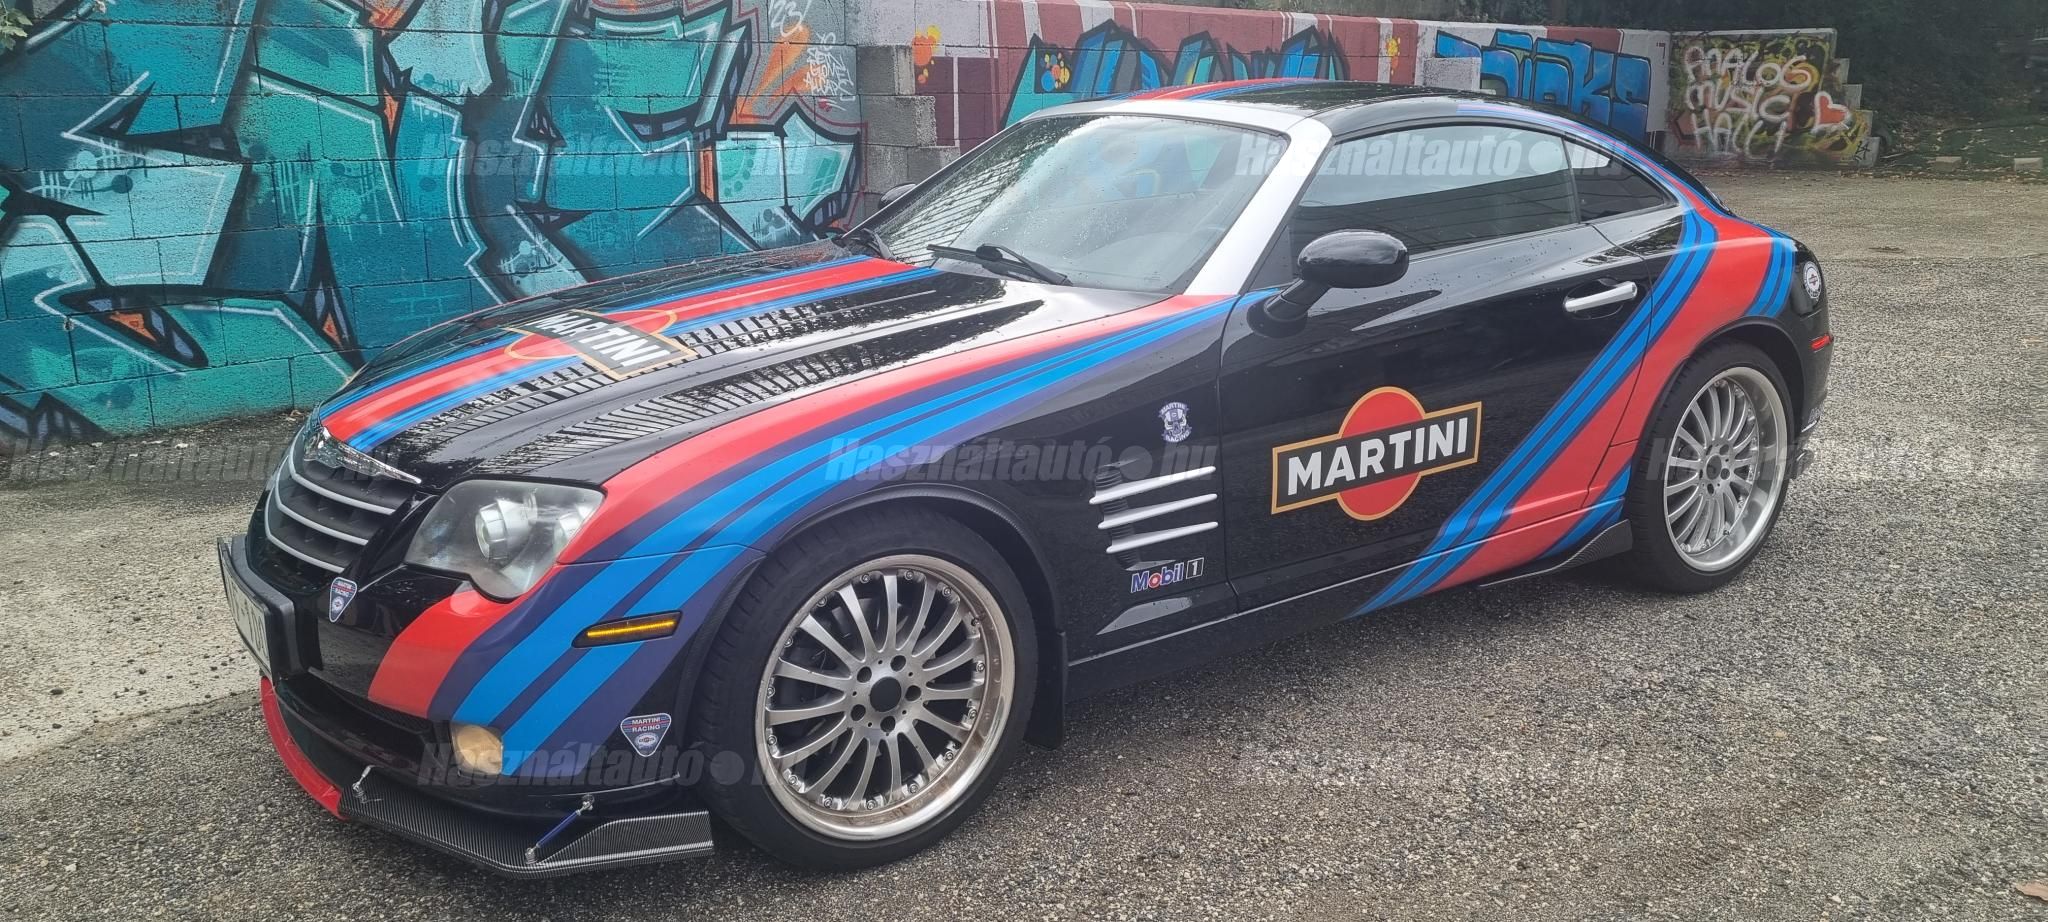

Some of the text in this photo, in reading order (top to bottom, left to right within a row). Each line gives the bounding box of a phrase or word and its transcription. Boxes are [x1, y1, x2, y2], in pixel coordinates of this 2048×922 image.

[525, 313, 671, 367] MARTINI
[1287, 417, 1469, 496] MARTINI
[1130, 562, 1185, 593] Mobil
[632, 716, 661, 725] MARTINI
[632, 724, 661, 733] RACING
